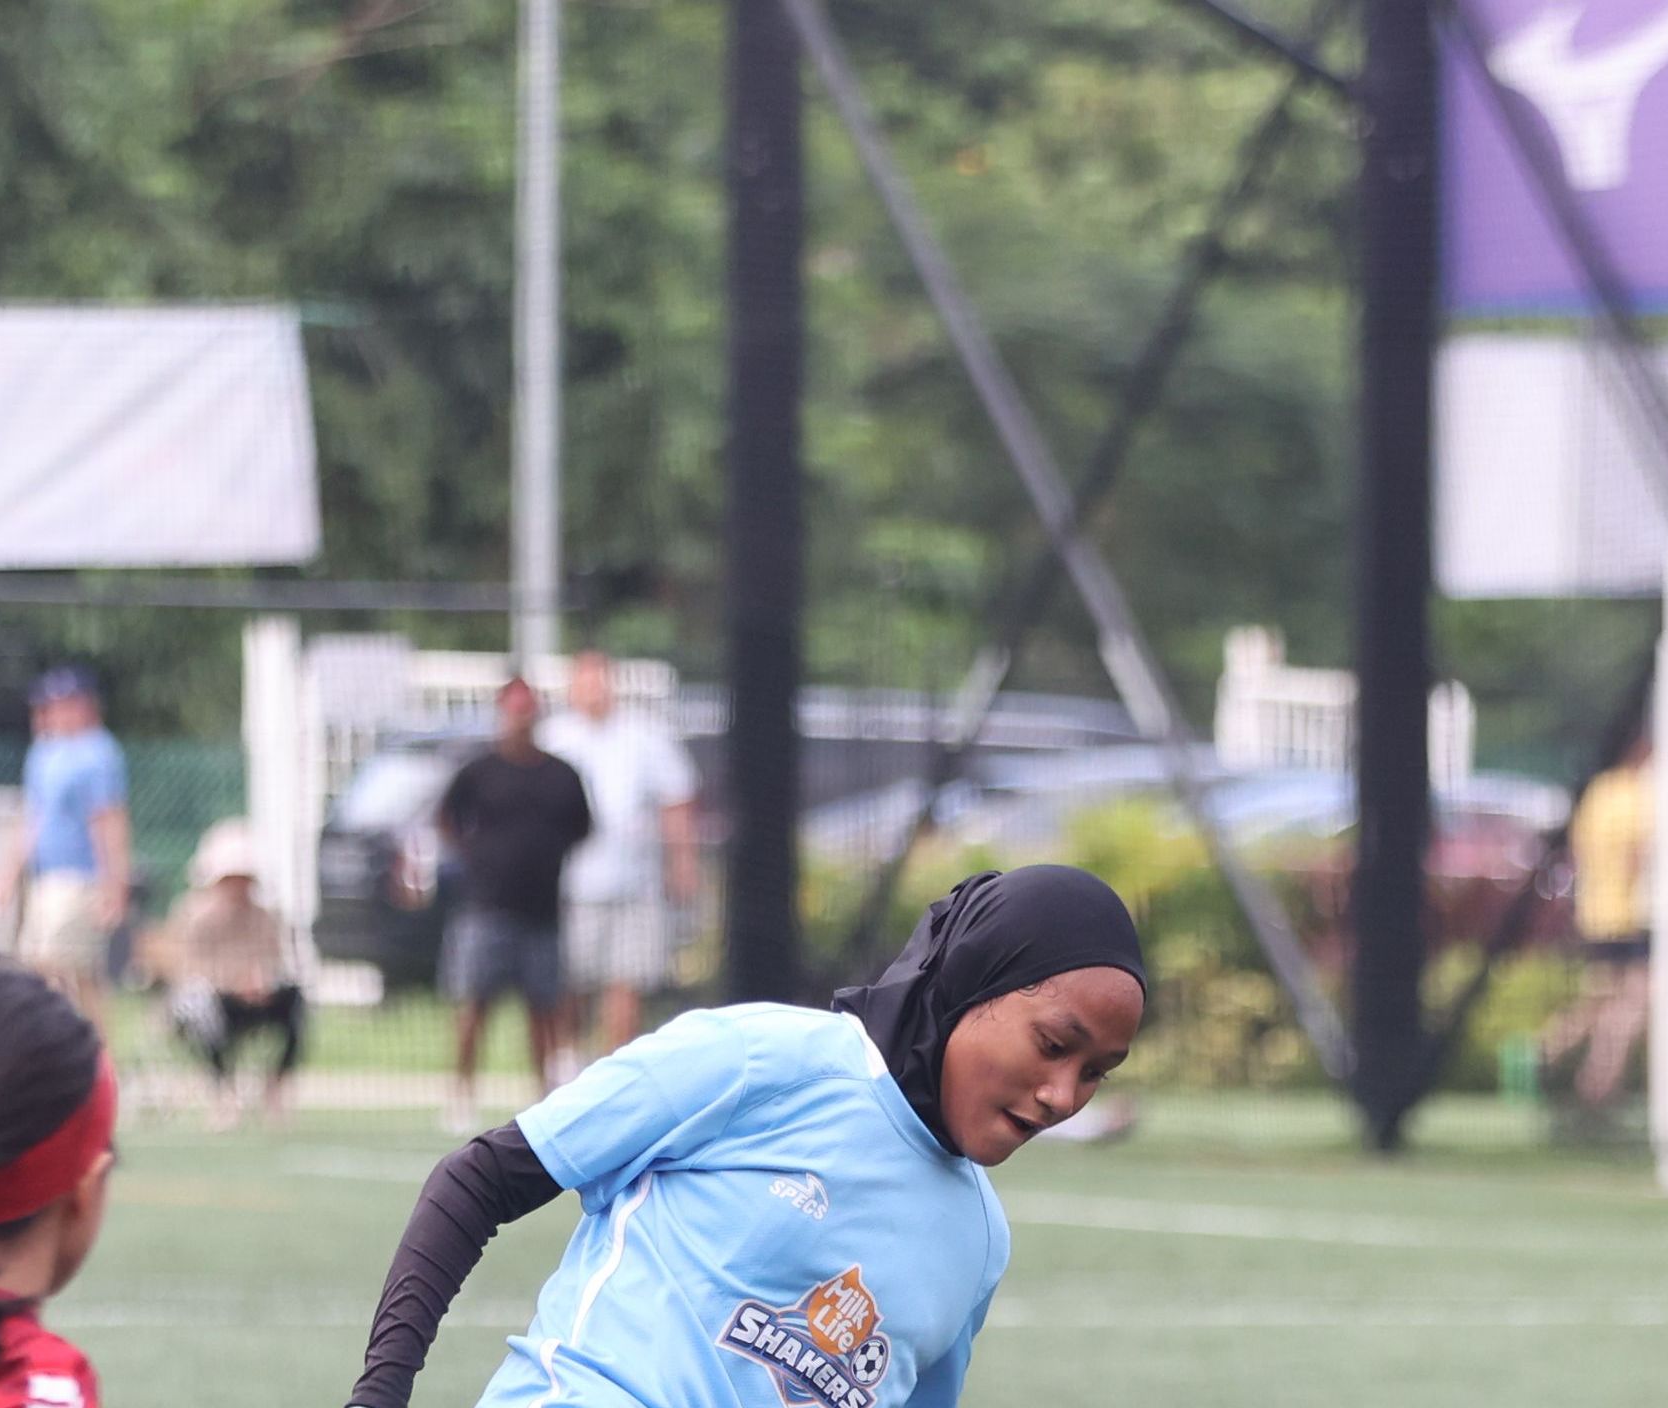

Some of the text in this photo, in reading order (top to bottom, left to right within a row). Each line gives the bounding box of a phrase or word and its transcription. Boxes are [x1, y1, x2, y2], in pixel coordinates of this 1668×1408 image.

[768, 1178, 829, 1221] SPECS
[823, 1278, 870, 1330] Milk
[812, 1305, 855, 1353] Life
